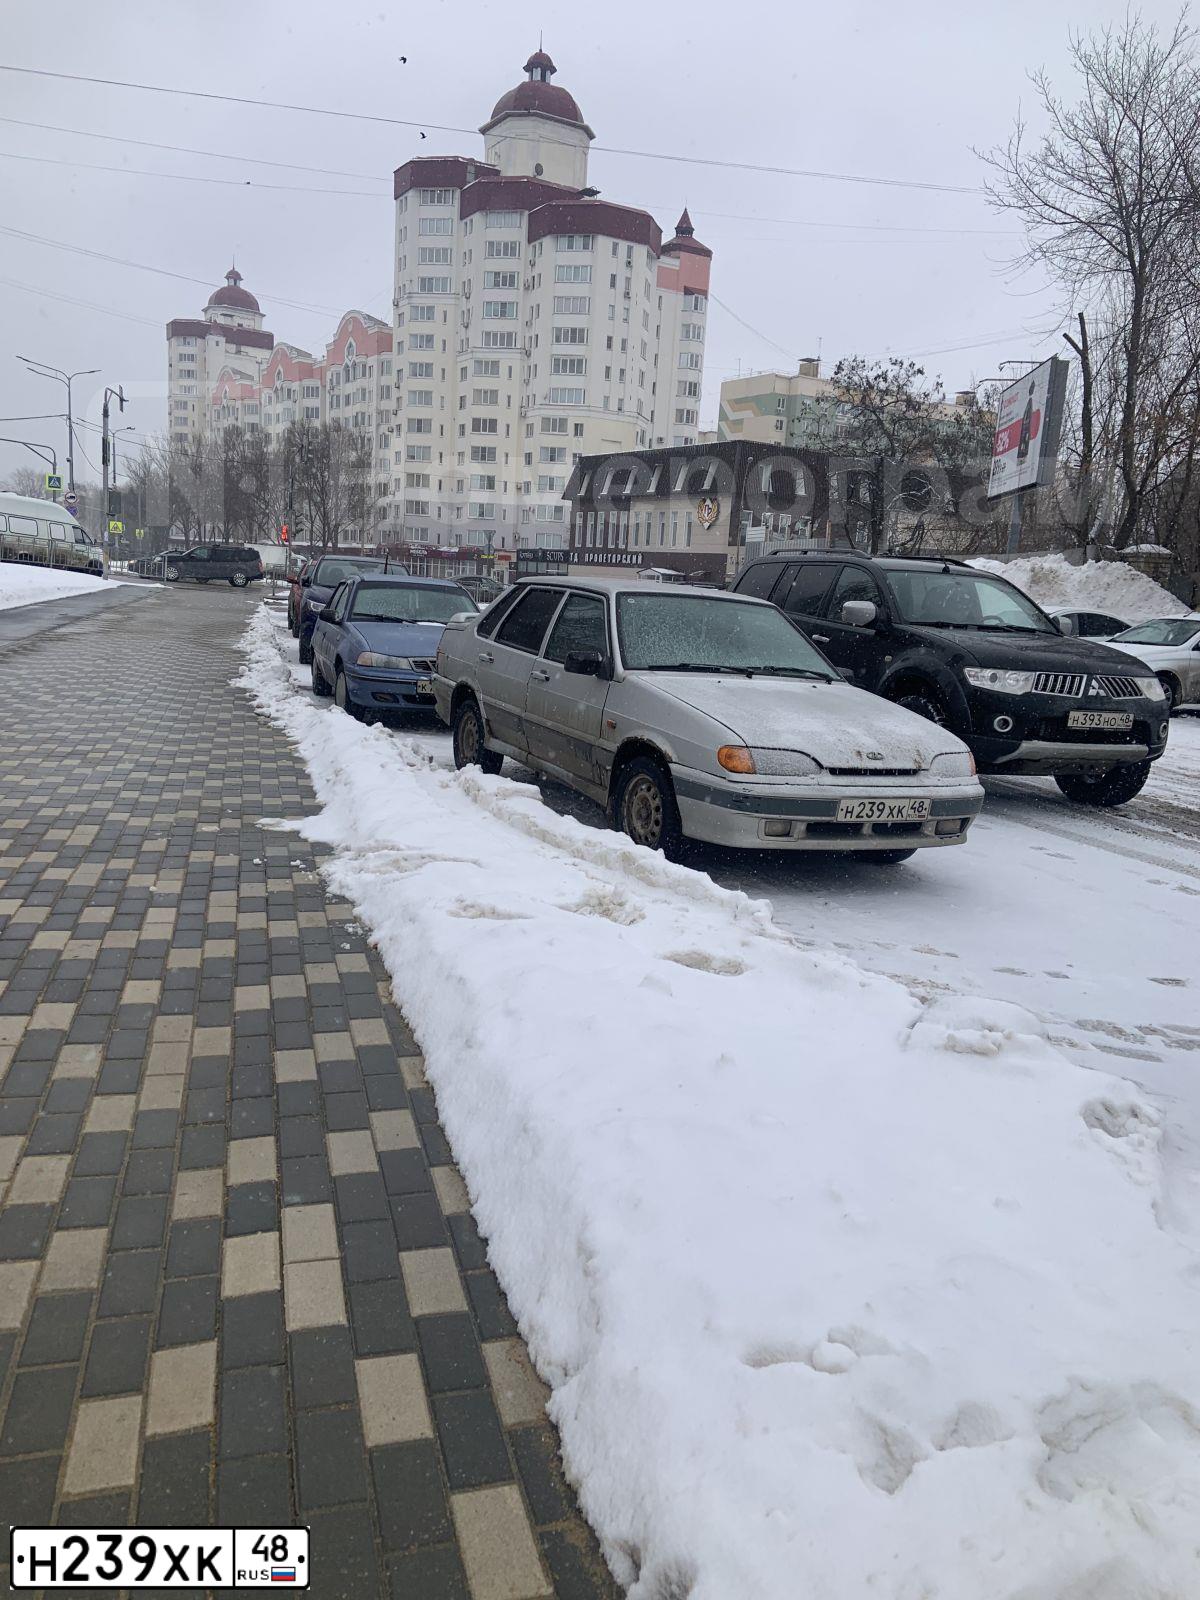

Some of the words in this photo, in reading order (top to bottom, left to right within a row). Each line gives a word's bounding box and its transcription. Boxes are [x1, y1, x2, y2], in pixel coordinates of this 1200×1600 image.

[584, 552, 643, 564] ПРОЛЕТАРСКИЙ
[1071, 713, 1117, 727] Н393НО
[1119, 713, 1131, 724] 48
[844, 801, 906, 819] Н239ХК
[910, 800, 925, 814] 48
